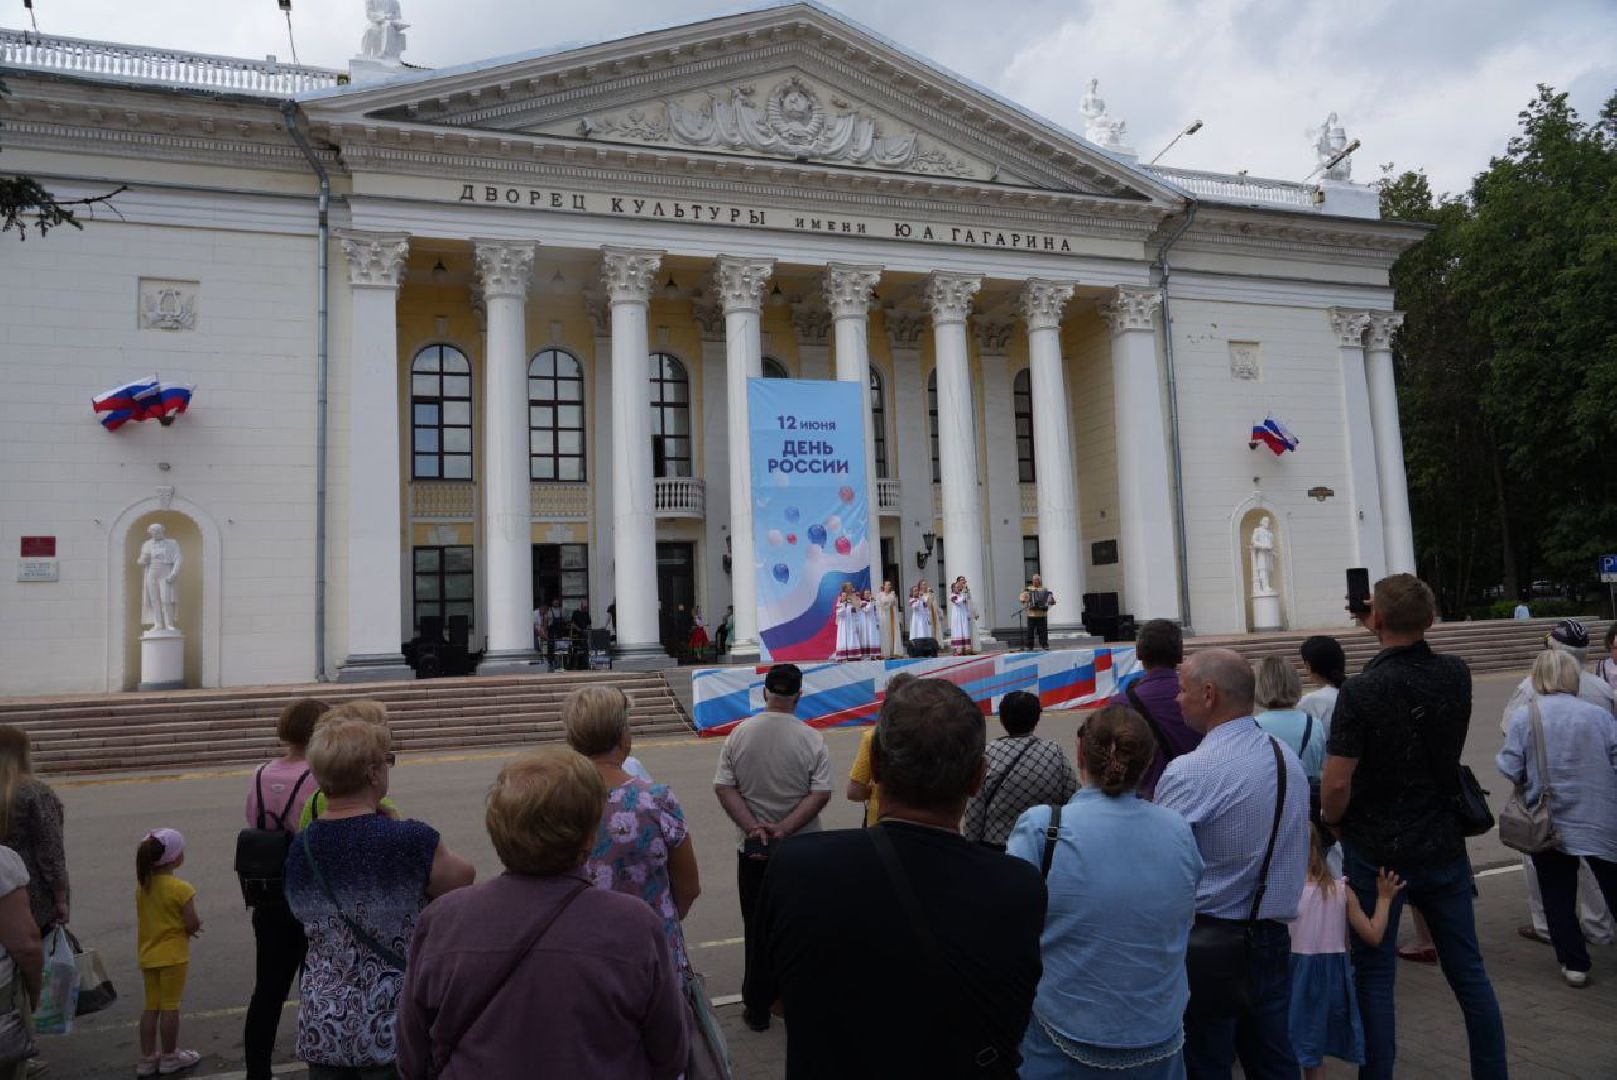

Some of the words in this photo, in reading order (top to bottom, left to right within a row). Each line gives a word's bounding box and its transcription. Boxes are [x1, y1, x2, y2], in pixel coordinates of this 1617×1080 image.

[460, 184, 586, 211] ДВОРЕЦ
[611, 197, 765, 225] КУЛЬТУРЫ
[795, 217, 866, 234] ИМЕНИ
[777, 415, 797, 430] 12
[800, 421, 837, 430] июня
[782, 440, 833, 457] ДЕНЬ
[768, 459, 849, 474] РОССИИ
